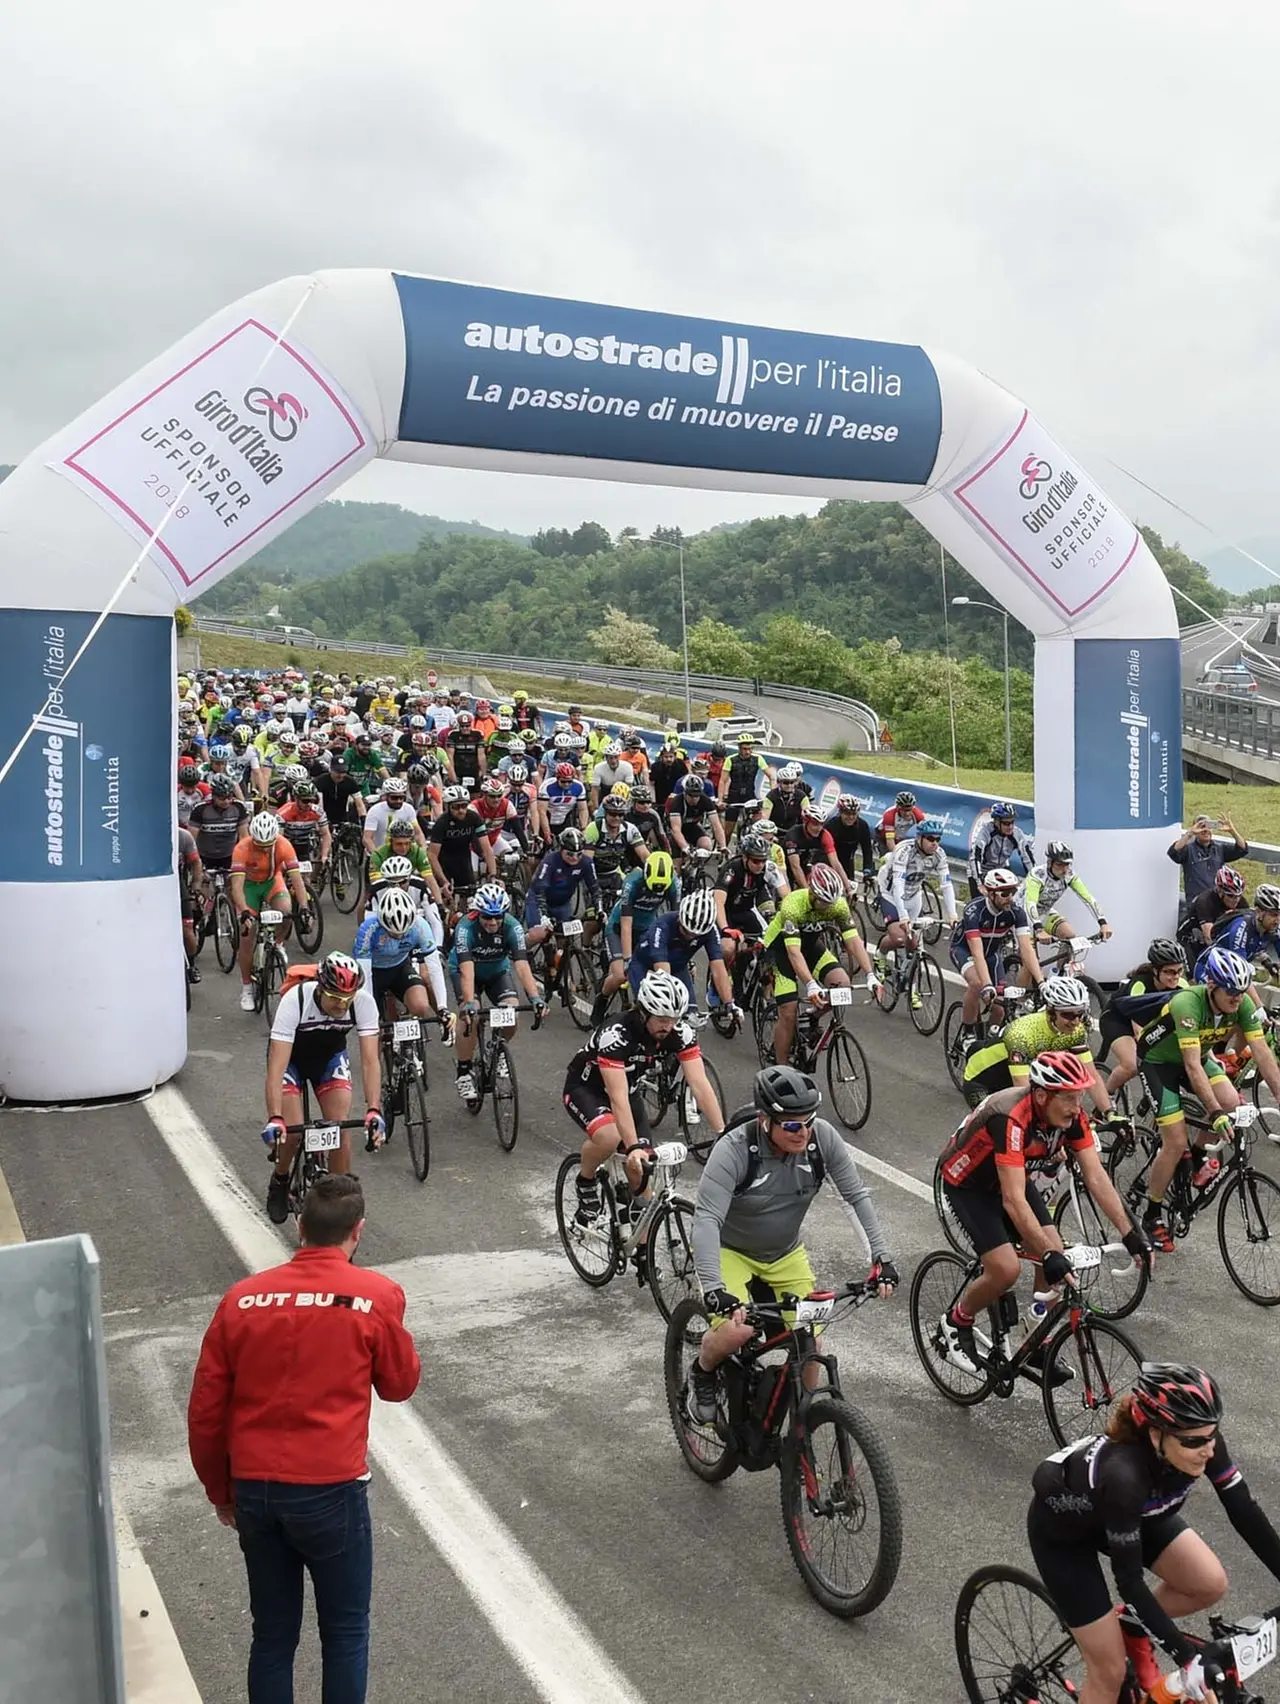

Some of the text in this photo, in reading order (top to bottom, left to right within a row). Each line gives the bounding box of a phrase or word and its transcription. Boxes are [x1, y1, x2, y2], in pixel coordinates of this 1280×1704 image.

[464, 321, 902, 397] autostrade per l'italia
[194, 390, 284, 485] Giro d'Italia
[466, 375, 899, 442] La passione di muovere il Paese
[140, 427, 239, 528] UFFICIALE
[163, 418, 251, 509] SPONSOR
[143, 474, 190, 519] 2018
[1022, 470, 1078, 534] Giro d'Italia
[1044, 493, 1096, 555] SPONSOR
[1051, 502, 1107, 570] UFFICIALE
[1088, 536, 1115, 568] 2018
[42, 625, 68, 867] autostrade per l'italia
[1126, 649, 1142, 818] autostrade per l'italia
[1158, 740, 1169, 794] Atlantia
[102, 756, 121, 864] gruppo Atlantia
[406, 1025, 419, 1037] 152
[320, 1131, 337, 1147] 507
[237, 1293, 373, 1314] OUT BURN
[1256, 1631, 1273, 1663] 231
